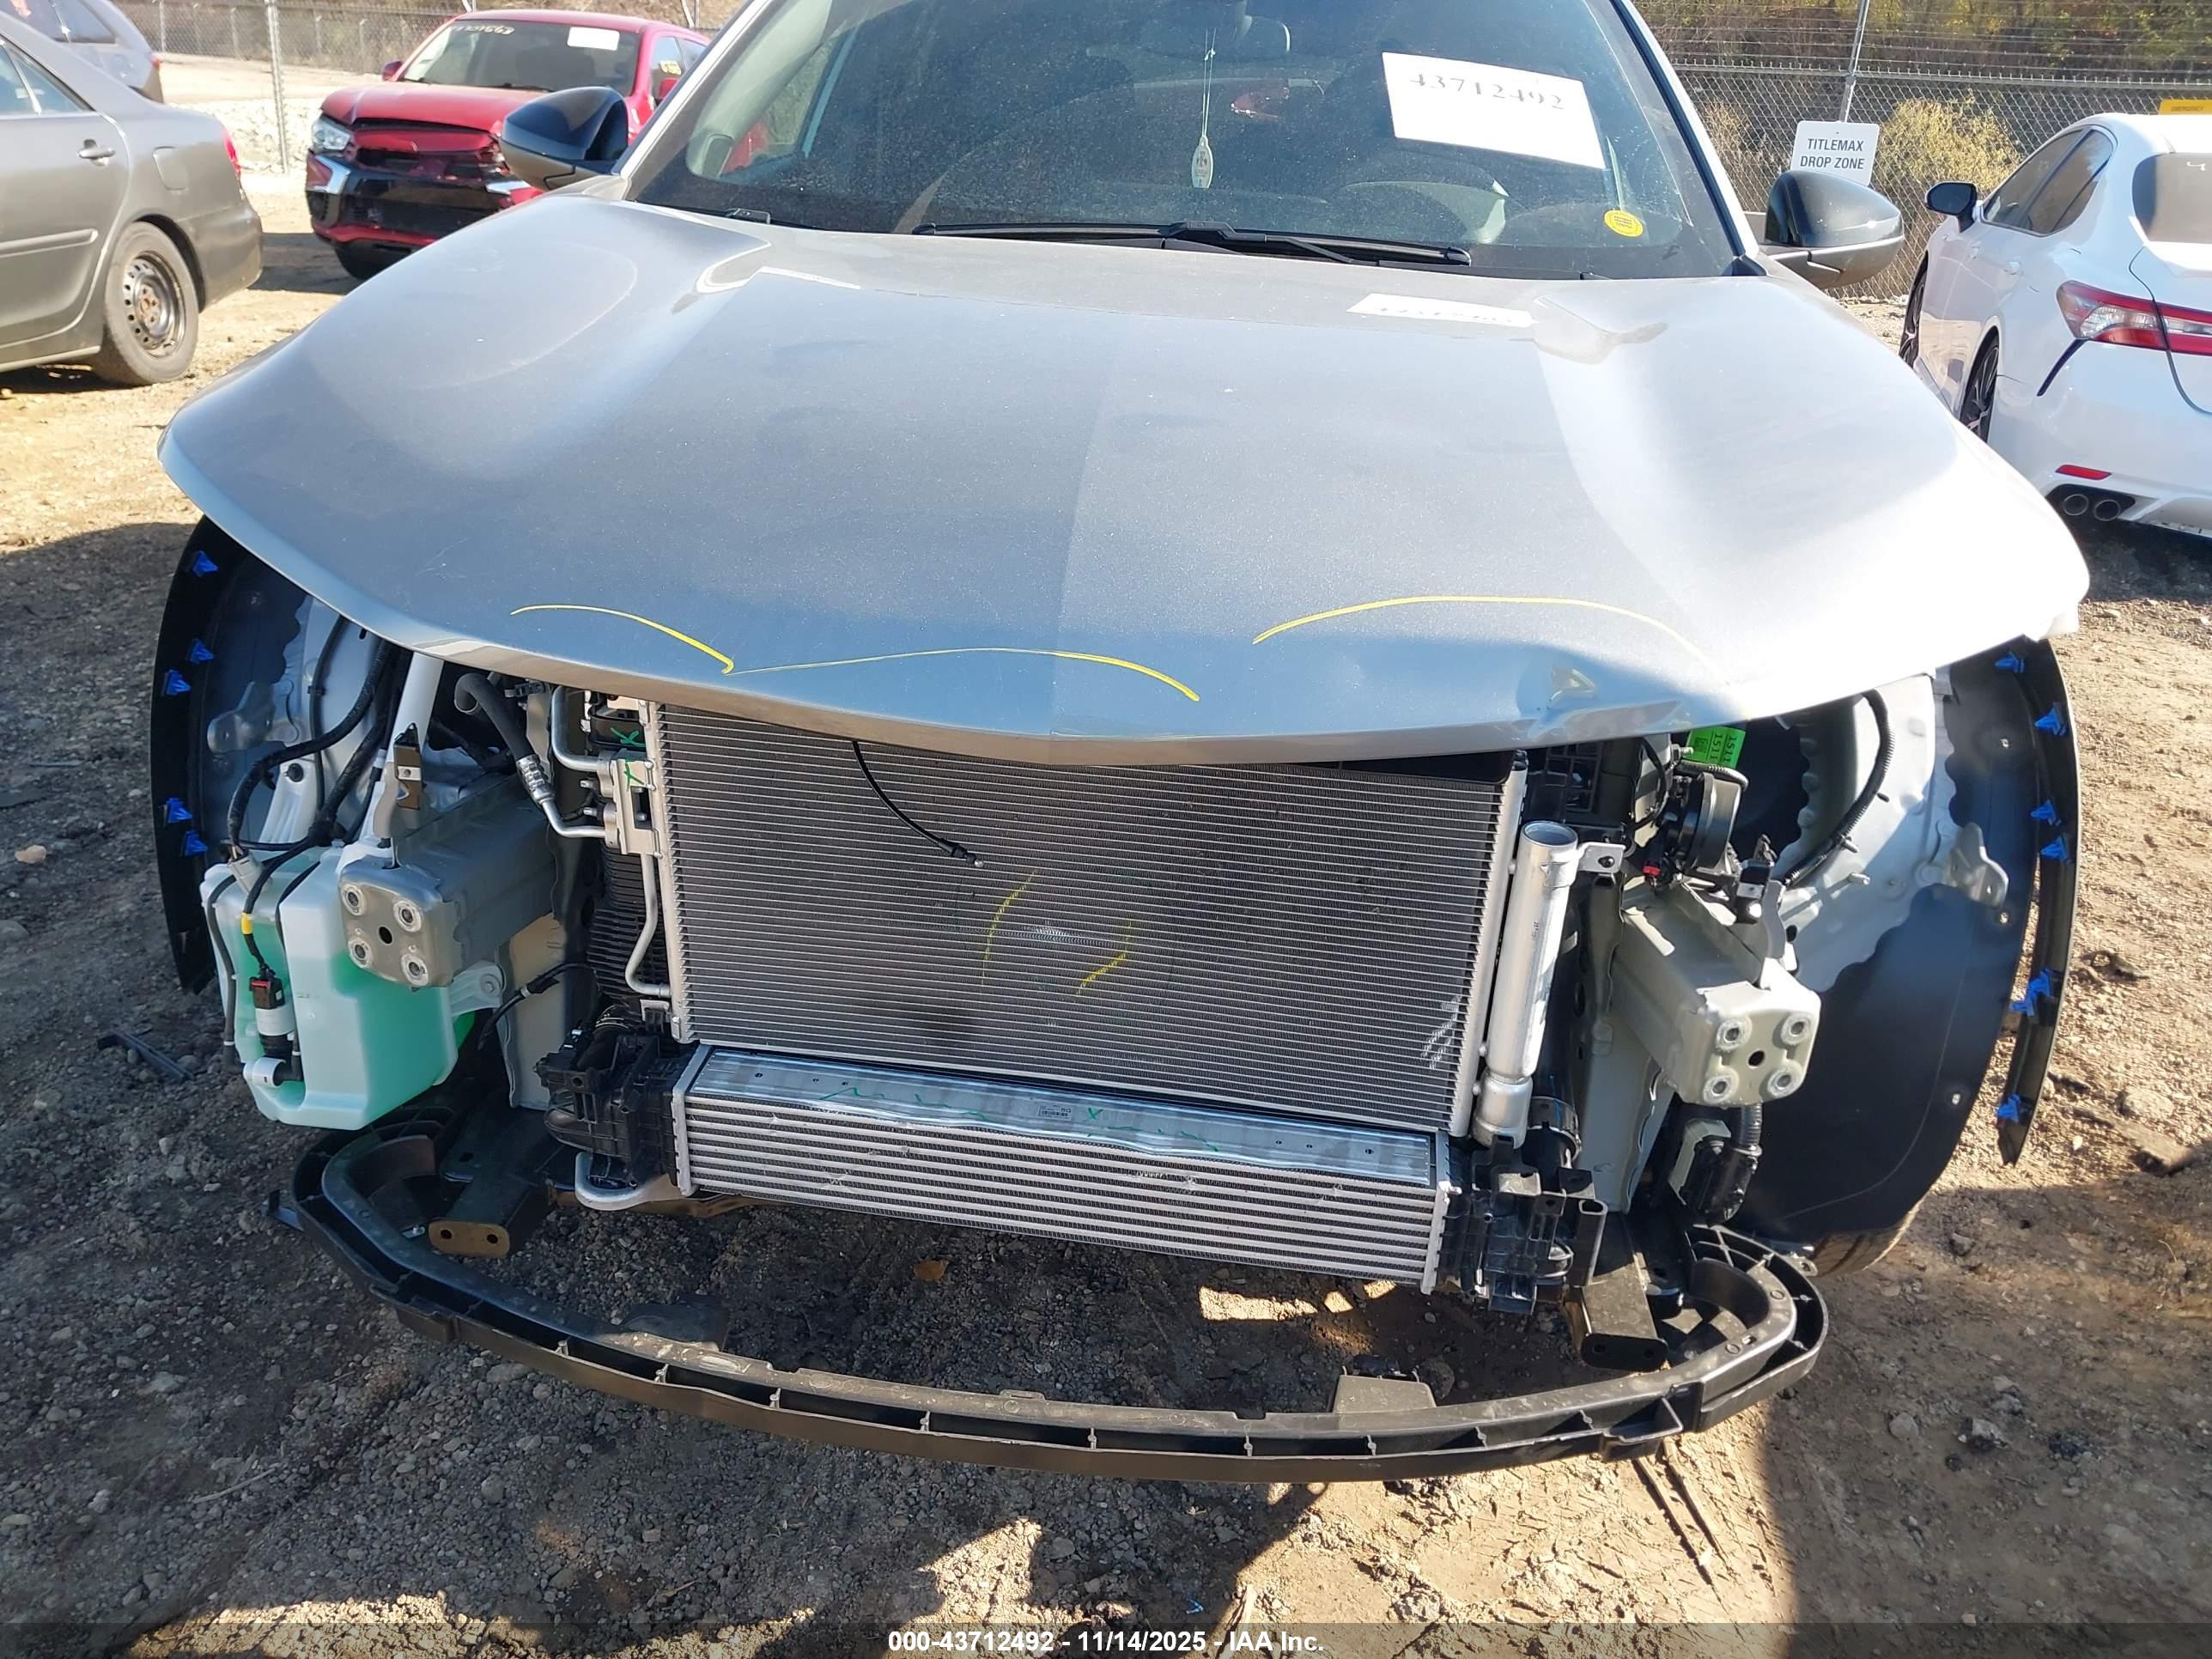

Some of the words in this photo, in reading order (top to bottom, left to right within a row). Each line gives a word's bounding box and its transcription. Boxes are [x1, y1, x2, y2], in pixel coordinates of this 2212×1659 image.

[1808, 138, 1864, 152] TITLEMAX
[1800, 155, 1832, 168] DROP
[1834, 157, 1865, 169] ZONE
